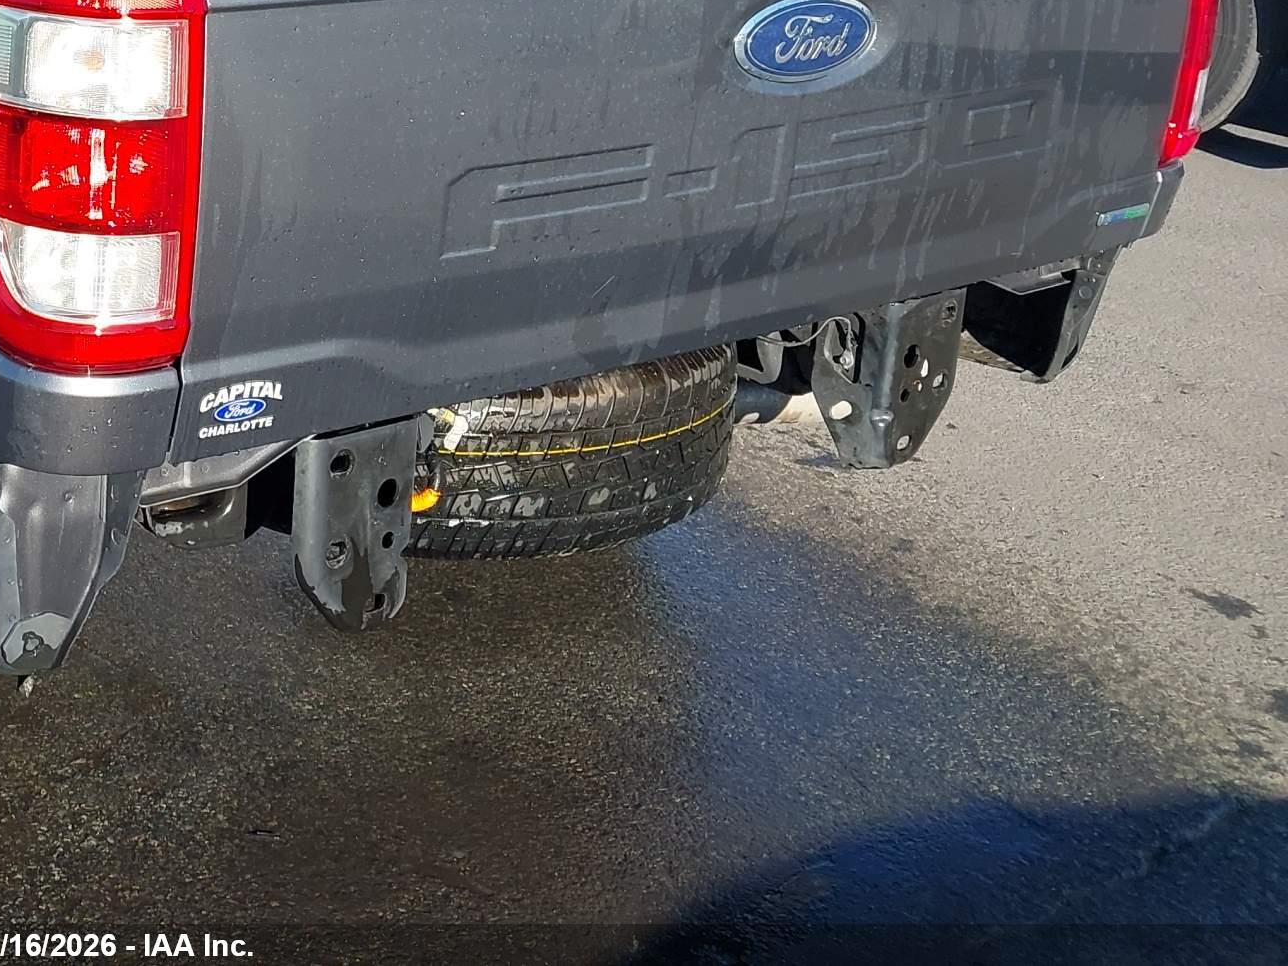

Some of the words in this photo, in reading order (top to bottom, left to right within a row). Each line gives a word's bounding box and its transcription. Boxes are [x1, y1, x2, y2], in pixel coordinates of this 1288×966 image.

[775, 13, 852, 64] Ford
[440, 88, 1054, 260] F-150
[199, 380, 283, 413] CAPITAL
[223, 401, 257, 419] Ford
[198, 416, 274, 439] CHARLOTTE
